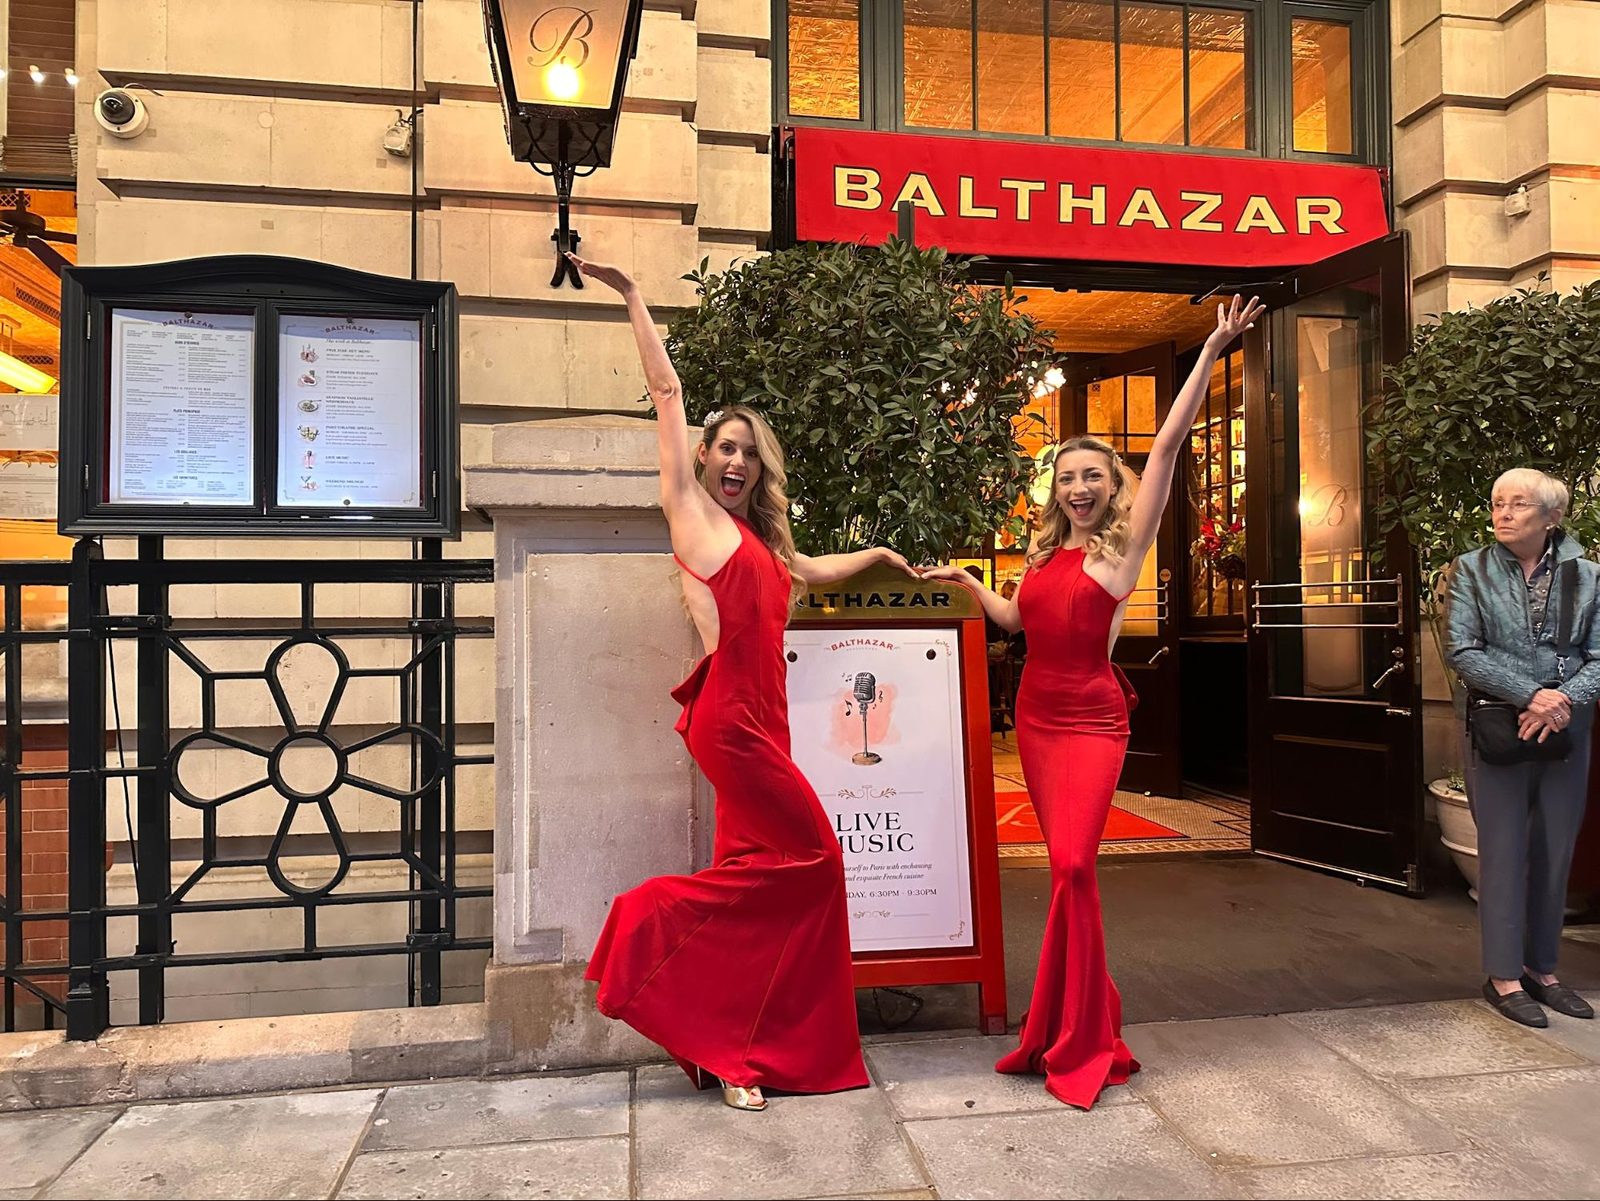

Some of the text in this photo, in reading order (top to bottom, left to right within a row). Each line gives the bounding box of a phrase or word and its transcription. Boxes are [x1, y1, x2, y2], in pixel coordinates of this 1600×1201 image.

[527, 6, 599, 70] B
[834, 165, 1348, 235] BALTHAZAR
[796, 592, 950, 608] LTHAZAR
[830, 638, 894, 652] BALTHAZAR
[836, 812, 901, 832] LIVE
[838, 832, 914, 854] USIC
[869, 863, 886, 871] Paris
[882, 872, 903, 881] French
[869, 889, 900, 898] 6:30PM
[907, 888, 937, 897] 9:30PM
